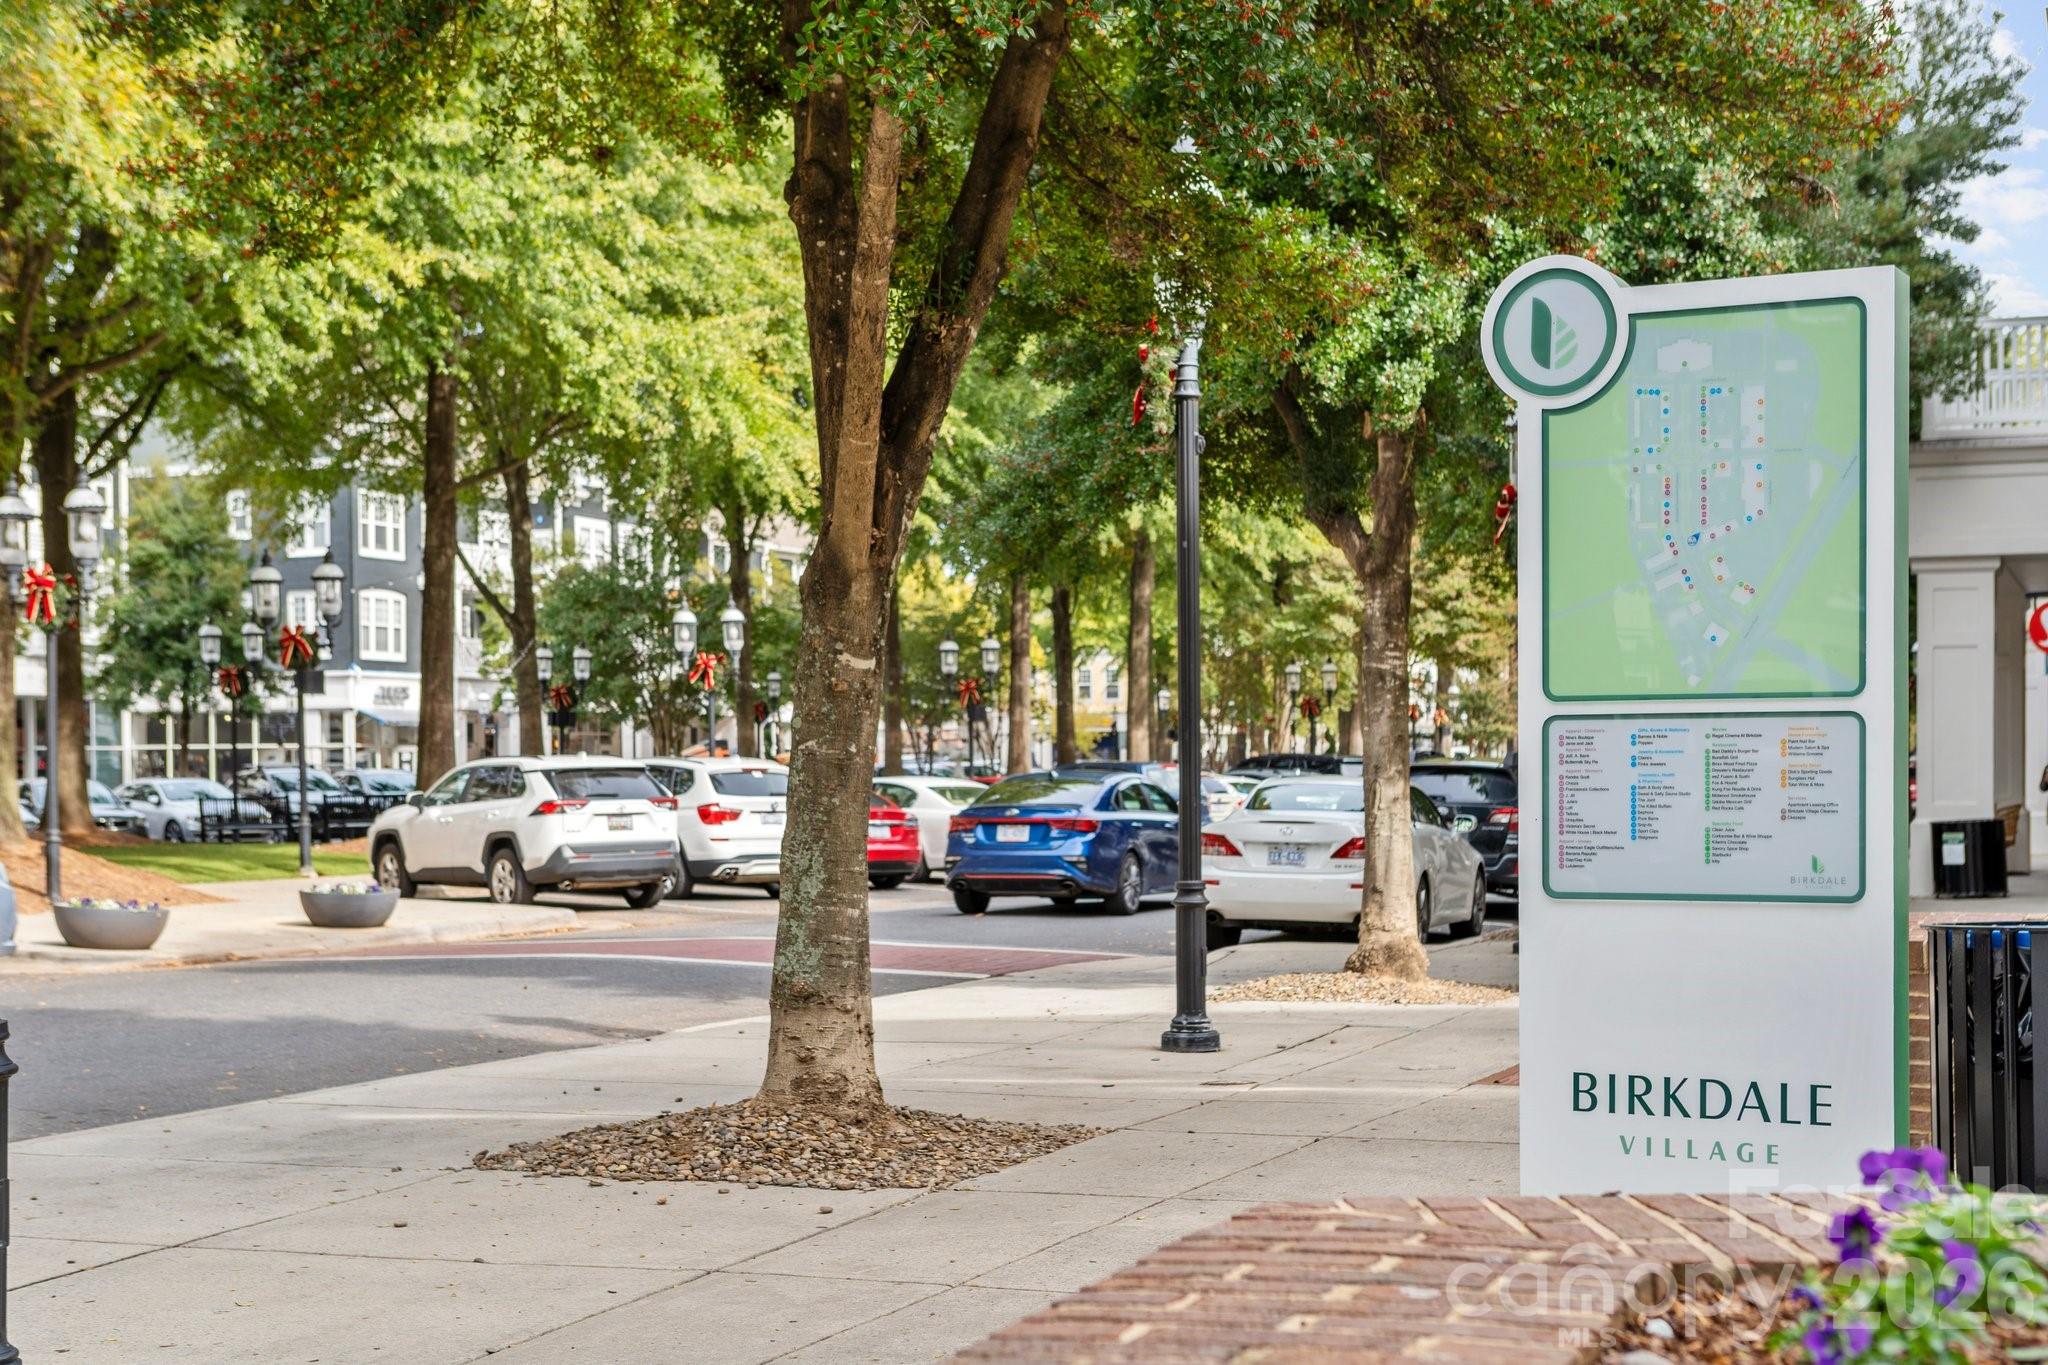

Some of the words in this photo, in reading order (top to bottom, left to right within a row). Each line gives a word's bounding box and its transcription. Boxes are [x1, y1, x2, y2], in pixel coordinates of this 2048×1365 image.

[1790, 876, 1847, 885] BIRKDALE
[1572, 1071, 1833, 1127] BIRKDALE
[1619, 1135, 1780, 1165] VILLAGE
